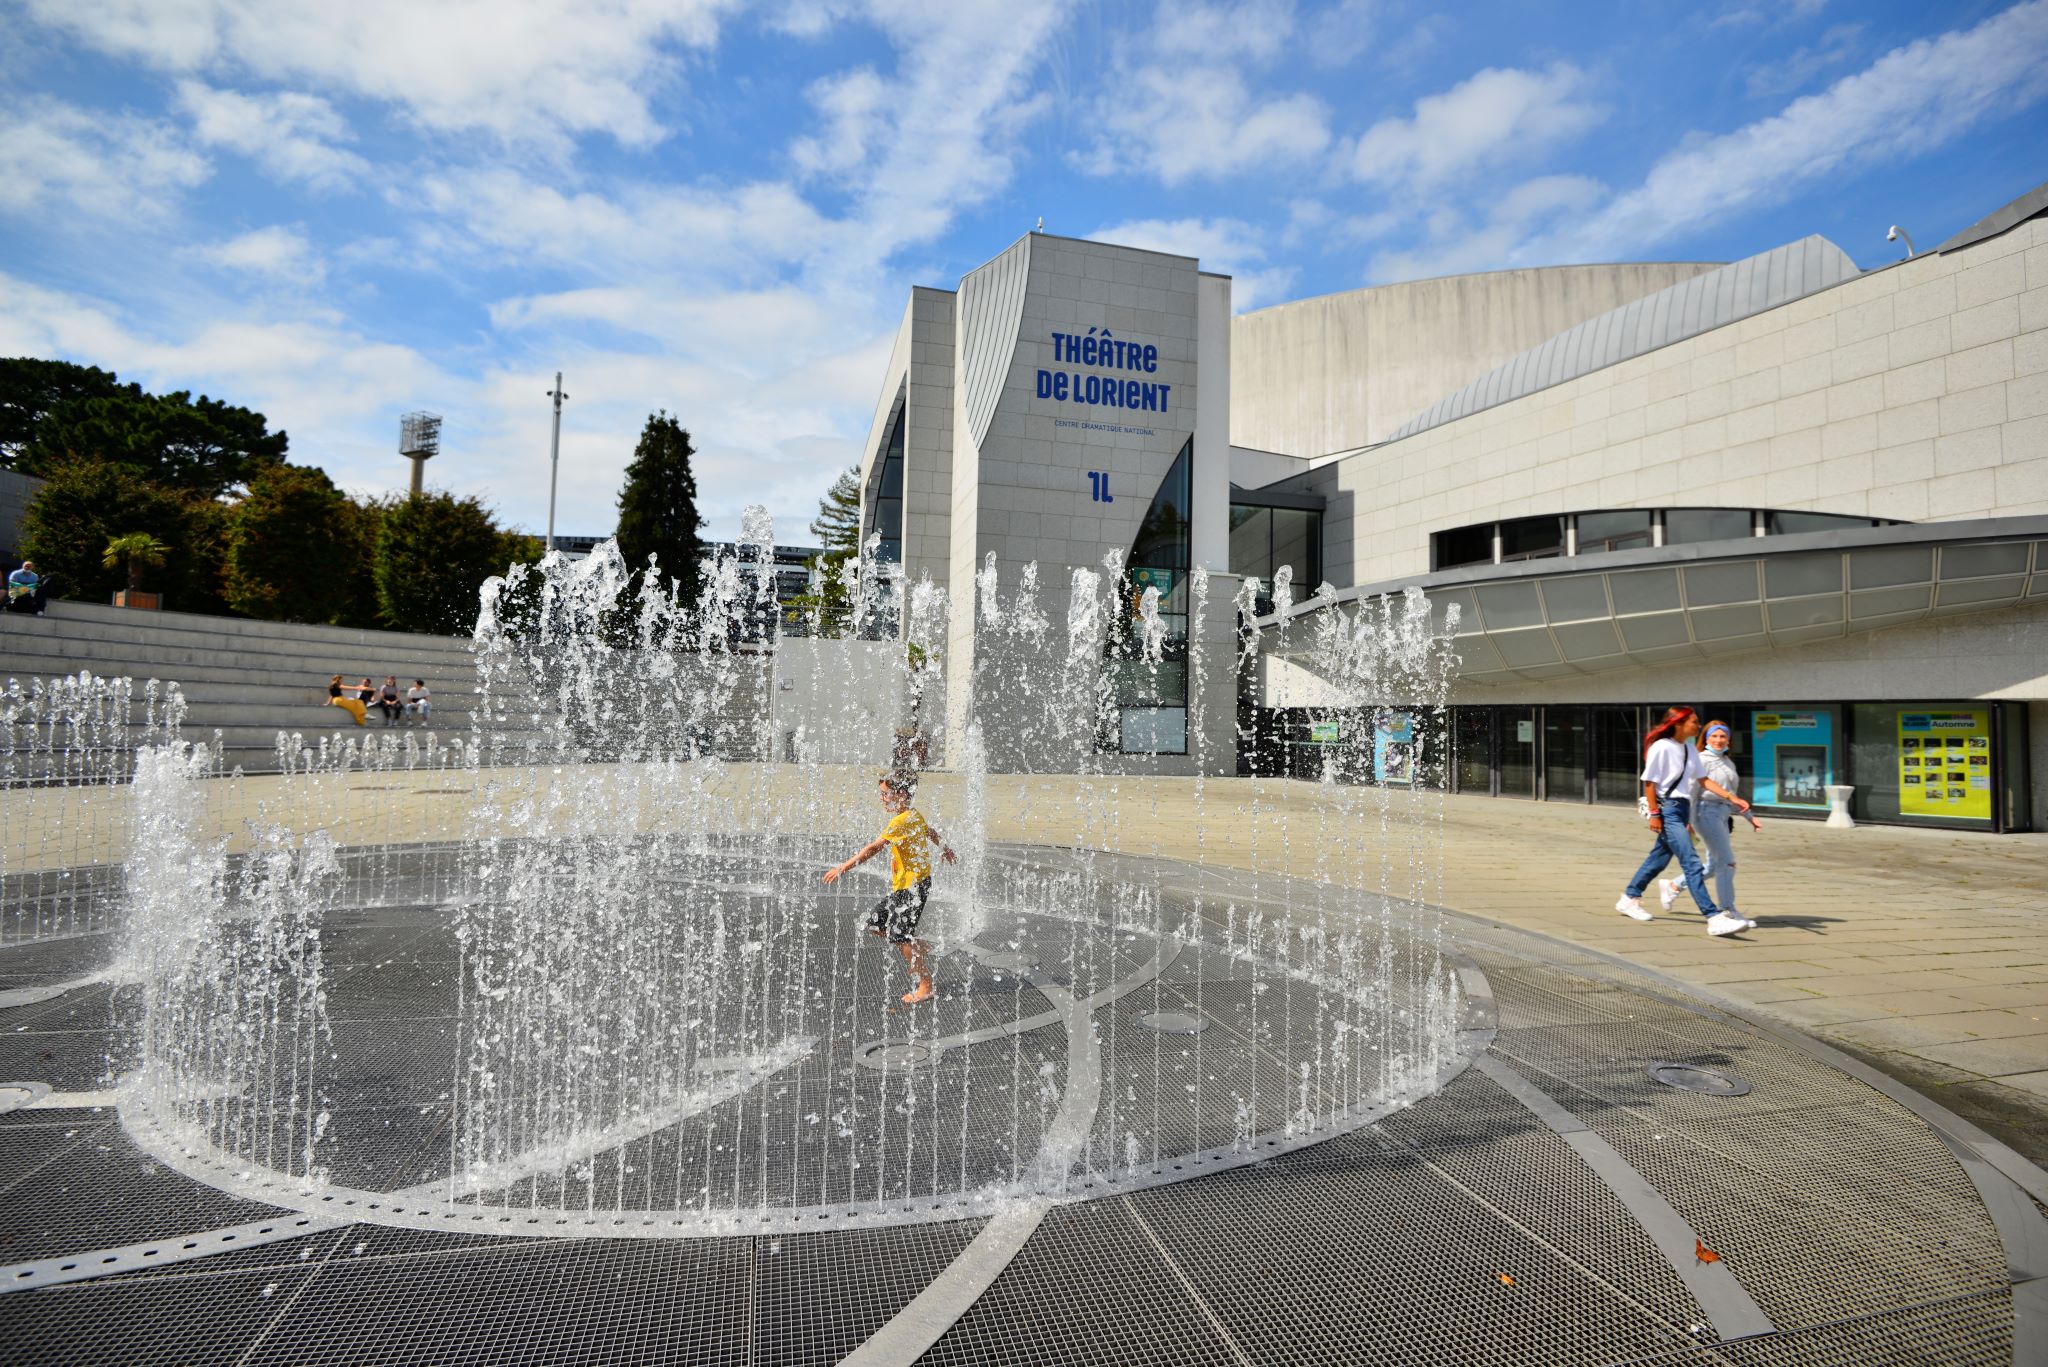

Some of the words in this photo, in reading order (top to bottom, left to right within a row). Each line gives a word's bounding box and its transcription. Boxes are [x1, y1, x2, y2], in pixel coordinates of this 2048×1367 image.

[1054, 419, 1079, 428] CENTRE
[1081, 422, 1123, 433] DRAMATIQUE
[1124, 427, 1155, 436] NATIONAL
